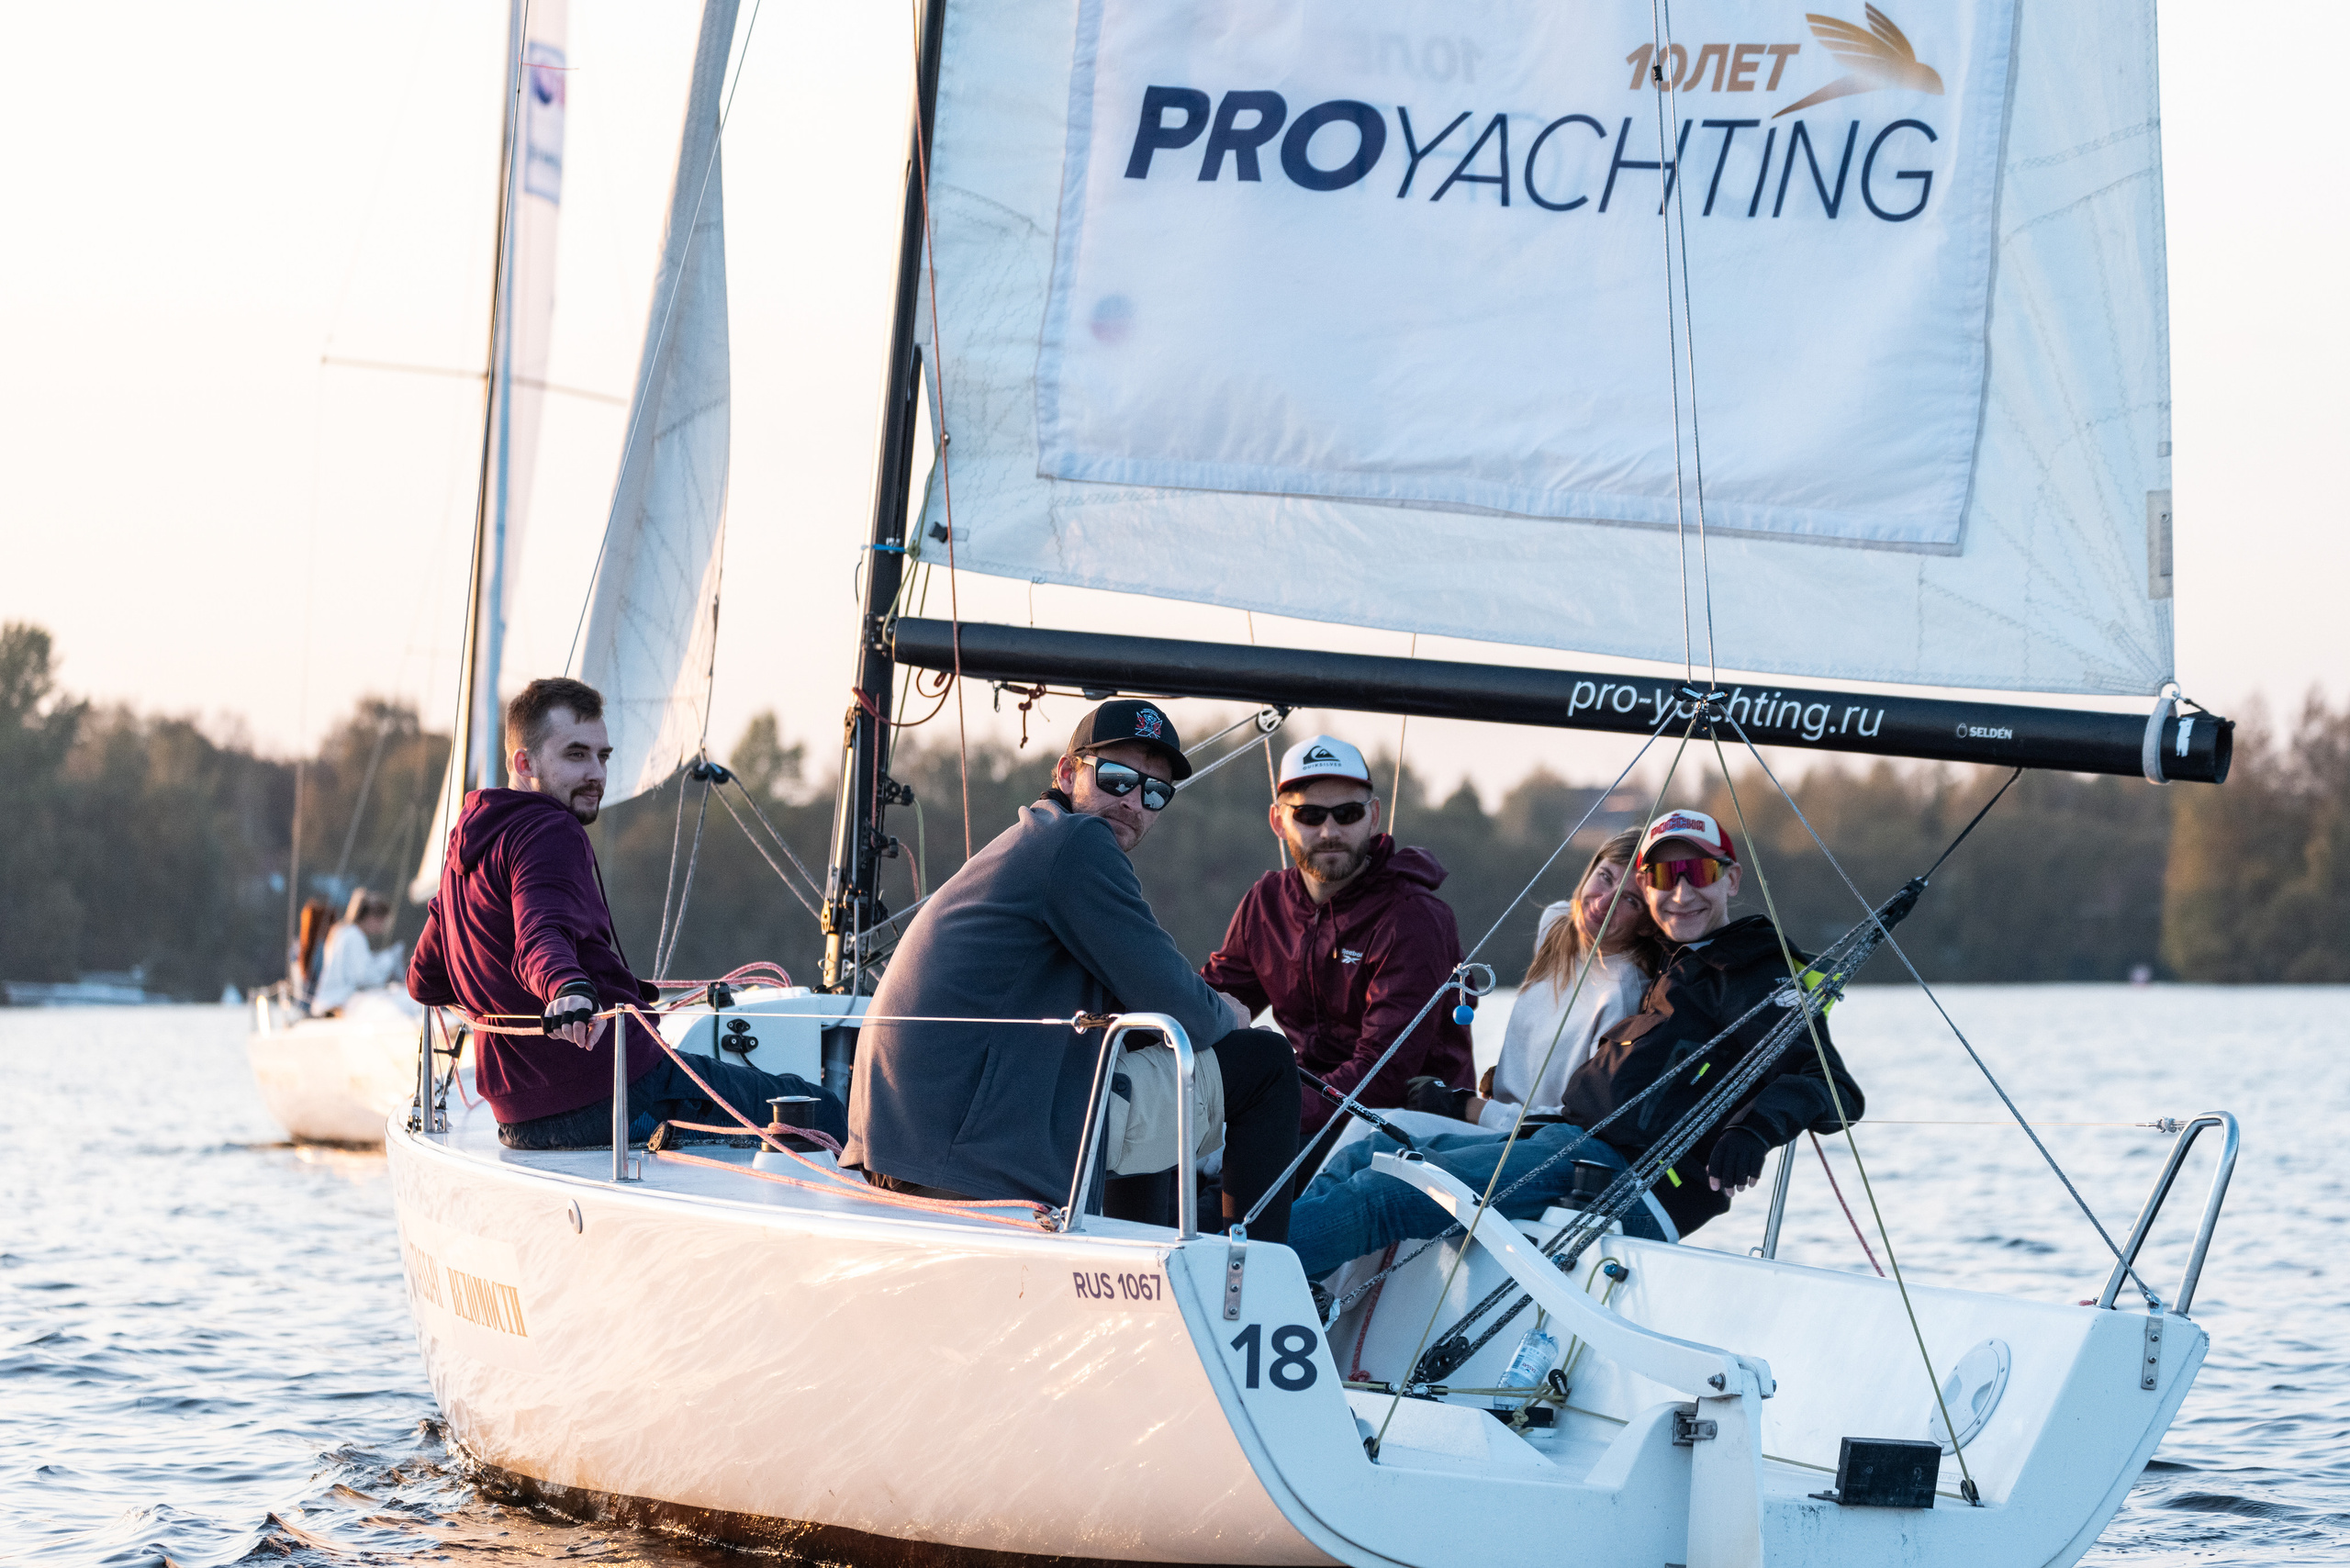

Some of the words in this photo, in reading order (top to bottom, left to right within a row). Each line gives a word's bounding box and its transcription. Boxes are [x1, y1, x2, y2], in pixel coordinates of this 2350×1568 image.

[1626, 43, 1801, 93] 10ЛЕТ
[1969, 726, 2013, 740] SELDÉN
[1303, 762, 1342, 770] QUIKSILVER
[1651, 816, 1706, 840] РОССИЯ
[1072, 1271, 1115, 1300] RUS
[1117, 1272, 1161, 1301] 1067
[446, 1266, 529, 1338] ВЕДОМОСТИ
[1230, 1324, 1318, 1392] 18
